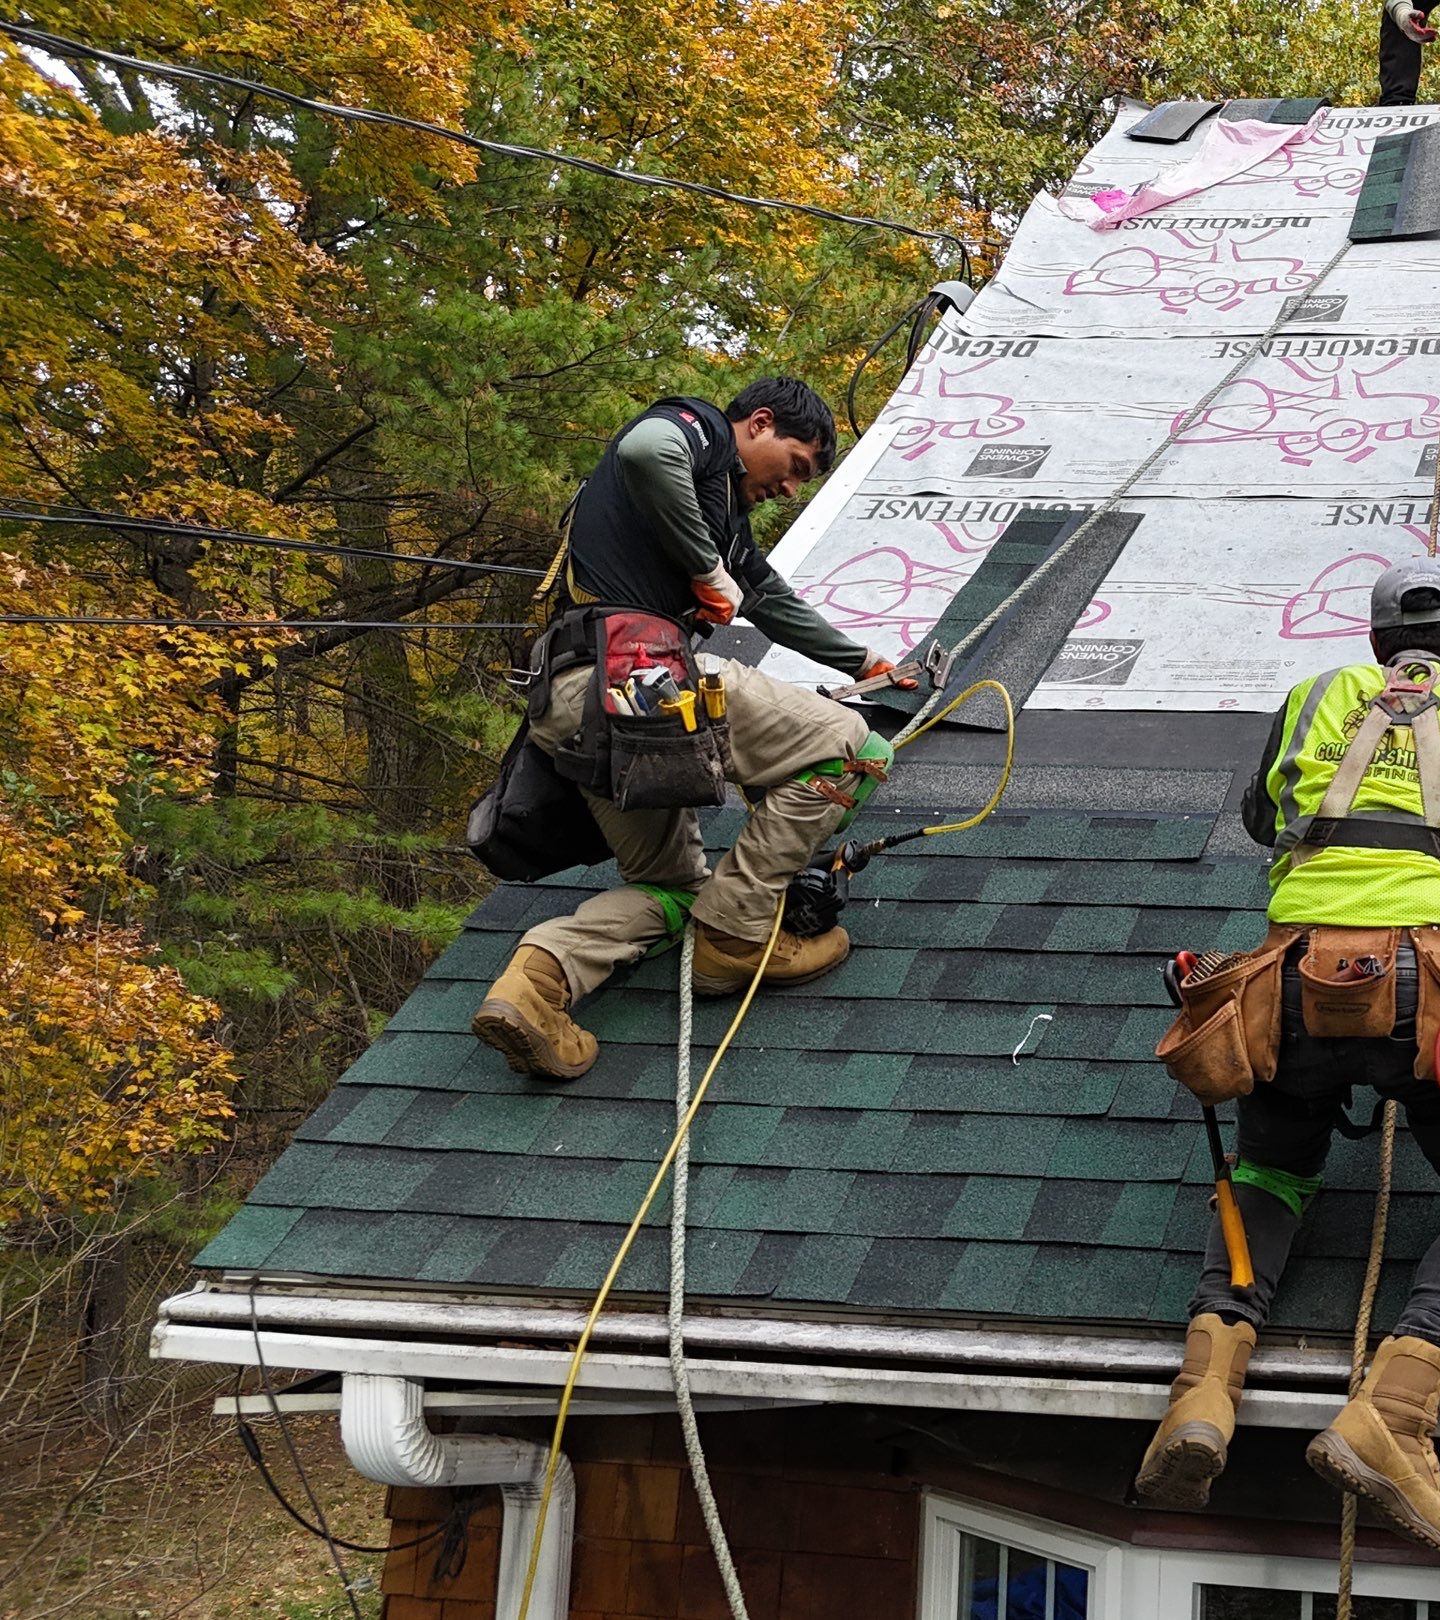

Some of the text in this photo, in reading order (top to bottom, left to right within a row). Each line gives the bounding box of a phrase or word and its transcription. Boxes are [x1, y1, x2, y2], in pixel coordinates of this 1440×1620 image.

[983, 448, 1047, 457] CORNING
[978, 454, 1029, 462] OWENS
[1063, 644, 1136, 654] CORNING
[1059, 652, 1119, 661] OWENS
[1365, 766, 1421, 783] FING
